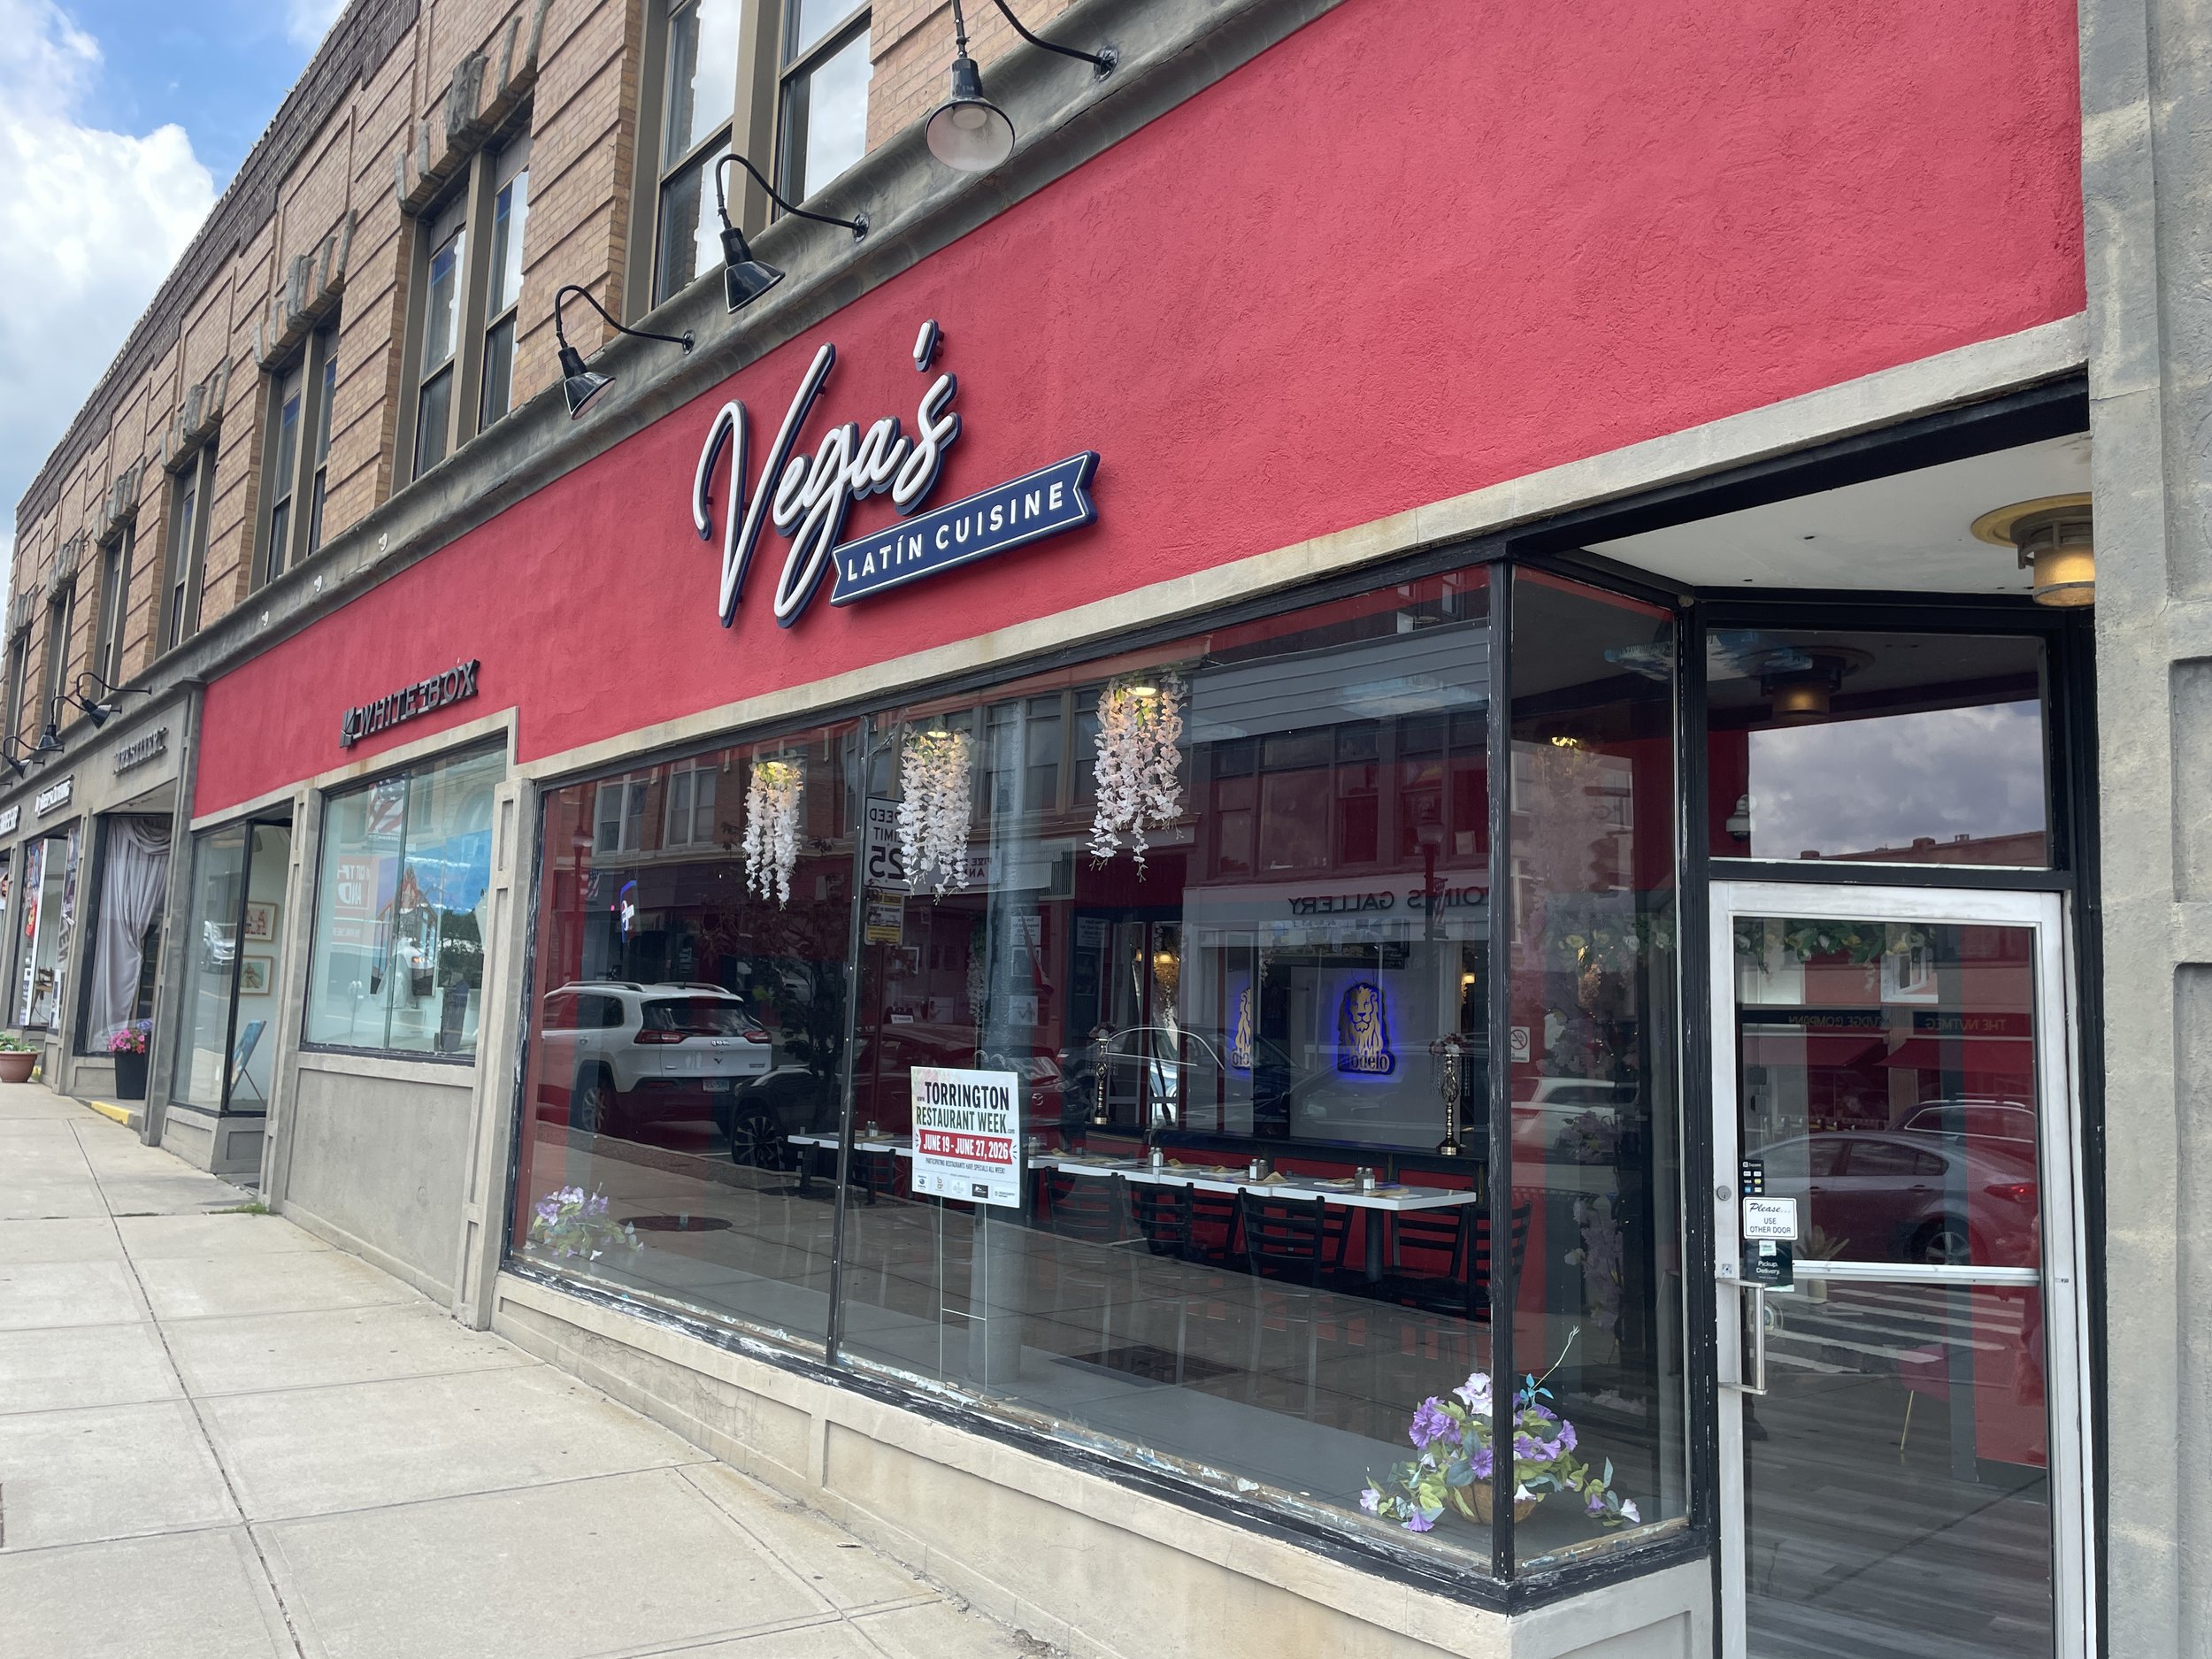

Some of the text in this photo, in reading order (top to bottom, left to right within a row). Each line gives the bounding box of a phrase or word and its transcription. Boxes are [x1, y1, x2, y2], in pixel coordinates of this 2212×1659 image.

[693, 319, 962, 627] Vega's
[847, 480, 1064, 582] LATÍN CUISINE
[359, 659, 480, 736] WHITE BOX
[916, 1106, 1007, 1133] RESTAURANT WEEK
[925, 1081, 1010, 1110] TORRINGTON
[923, 1133, 941, 1152] JUNE
[942, 1136, 950, 1153] 19
[955, 1138, 974, 1156] JUNE
[976, 1140, 987, 1160] 27,
[988, 1141, 1009, 1160] 2026
